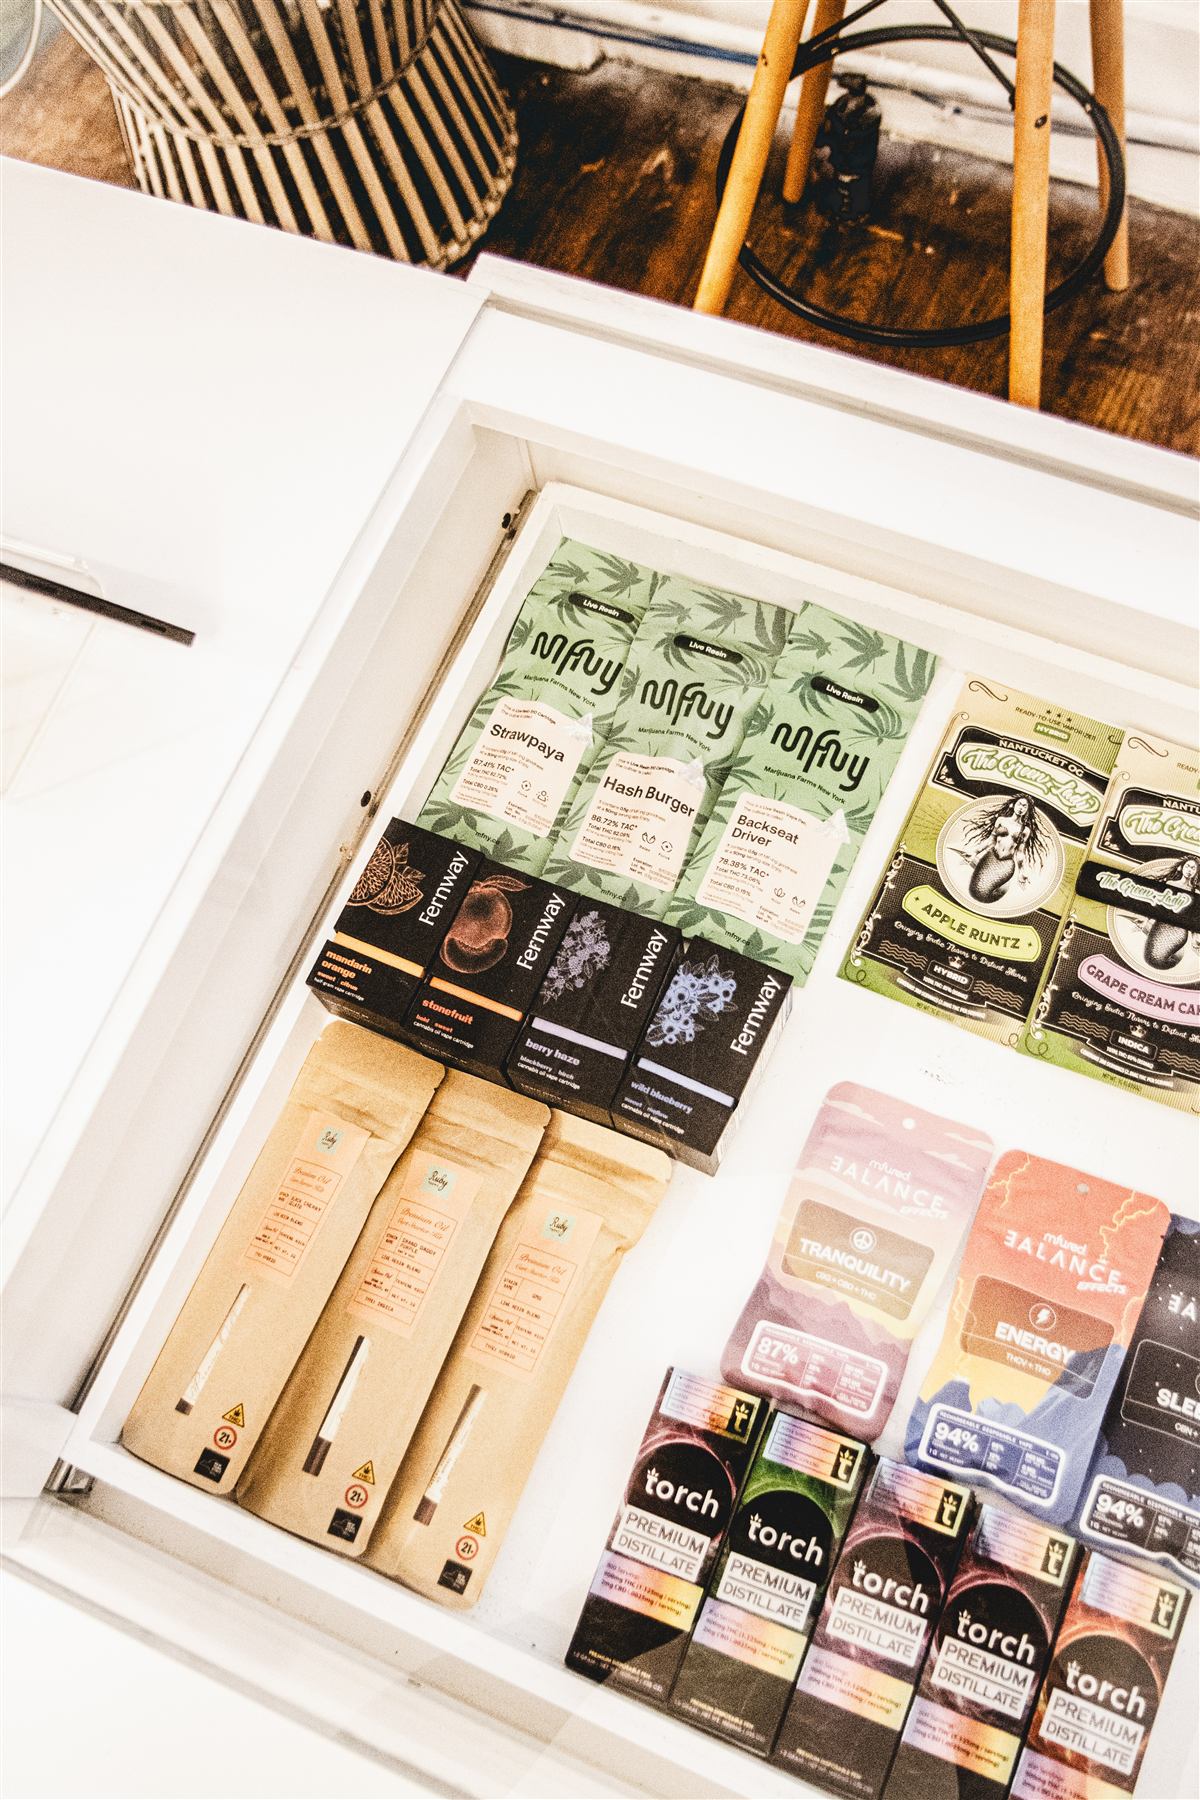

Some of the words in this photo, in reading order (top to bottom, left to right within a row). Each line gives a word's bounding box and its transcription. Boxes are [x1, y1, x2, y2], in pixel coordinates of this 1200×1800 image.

[583, 600, 600, 610] Live
[601, 605, 620, 617] Resin
[689, 641, 705, 651] Live
[706, 646, 727, 659] Resin
[524, 675, 549, 684] Marijuana
[549, 677, 568, 692] Farms
[569, 687, 583, 698] New
[583, 696, 596, 707] York
[826, 684, 842, 696] Live
[841, 690, 864, 705] Resin
[490, 724, 565, 762] Strawpaya
[638, 727, 665, 735] Marijuana
[666, 729, 684, 737] Farms
[686, 734, 698, 744] New
[698, 742, 711, 751] York
[999, 739, 1068, 771] NANTUCKET
[1067, 762, 1085, 778] OG
[603, 776, 642, 798] Hash
[645, 786, 695, 817] Burger
[764, 765, 797, 780] Marijuana
[797, 776, 817, 789] Farms
[817, 784, 832, 797] New
[831, 791, 845, 804] York
[961, 748, 997, 771] The
[996, 755, 1050, 794] Green
[1047, 779, 1100, 815] Lady
[591, 814, 619, 828] 86.72%
[731, 827, 772, 847] Driver
[737, 815, 800, 845] Backseat
[1126, 811, 1163, 834] The
[718, 857, 747, 871] 78.38%
[418, 851, 470, 927] Fernway
[1096, 871, 1121, 887] The
[1119, 878, 1159, 906] Green
[1153, 888, 1192, 913] Lady
[516, 893, 566, 971] Fernway
[921, 904, 967, 936] APPLE
[969, 927, 1020, 950] RUNTZ
[321, 961, 356, 979] orange
[326, 951, 372, 974] mandarin
[620, 929, 668, 1009] Fernway
[934, 964, 968, 985] HYBRID
[971, 952, 978, 961] to
[979, 956, 1004, 972] Distant
[345, 989, 365, 1001] cartridge
[1087, 964, 1127, 995] GRAPE
[1129, 988, 1176, 1012] CREAM
[416, 1014, 429, 1023] bold
[434, 1022, 453, 1033] sweet
[422, 999, 474, 1025] stonefruit
[730, 974, 782, 1055] Fernway
[413, 1021, 433, 1034] cannabis
[441, 1032, 452, 1040] vape
[453, 1036, 474, 1049] cartridge
[1118, 1035, 1150, 1054] INDICA
[1160, 1023, 1188, 1039] Distant
[520, 1055, 552, 1072] blackberry
[558, 1069, 575, 1080] birch
[525, 1038, 553, 1058] berry
[554, 1047, 580, 1066] haze
[518, 1062, 538, 1074] cannabis
[546, 1073, 558, 1082] vape
[559, 1077, 581, 1090] cartridge
[630, 1081, 650, 1095] wild
[650, 1086, 693, 1115] blueberry
[621, 1102, 642, 1116] cannabis
[662, 1119, 685, 1135] cartridge
[428, 1170, 448, 1191] Ruby
[869, 1159, 912, 1180] mfused
[550, 1217, 568, 1237] Ruby
[1043, 1232, 1088, 1255] mfused
[799, 1238, 911, 1293] TRANQUILITY
[836, 1278, 854, 1291] CBD
[860, 1287, 877, 1300] THC
[757, 1335, 799, 1365] 87%
[995, 1321, 1077, 1365] ENERGY
[1007, 1353, 1026, 1366] THCV
[1034, 1363, 1051, 1376] THC
[934, 1422, 979, 1452] 94%
[1175, 1422, 1192, 1437] CBN
[645, 1467, 719, 1519] torch
[1097, 1493, 1144, 1528] 94%
[625, 1511, 704, 1555] PREMIUM
[748, 1513, 823, 1566] torch
[618, 1535, 696, 1575] DISTILLATE
[730, 1559, 811, 1600] PREMIUM
[852, 1559, 929, 1614] torch
[723, 1582, 803, 1621] DISTILLATE
[839, 1593, 922, 1637] PREMIUM
[832, 1617, 914, 1658] DISTILLATE
[957, 1609, 1035, 1665] torch
[945, 1643, 1028, 1688] PREMIUM
[938, 1666, 1019, 1710] DISTILLATE
[1066, 1660, 1146, 1718] torch
[1053, 1696, 1139, 1745] PREMIUM
[1046, 1721, 1131, 1766] DISTILLATE
